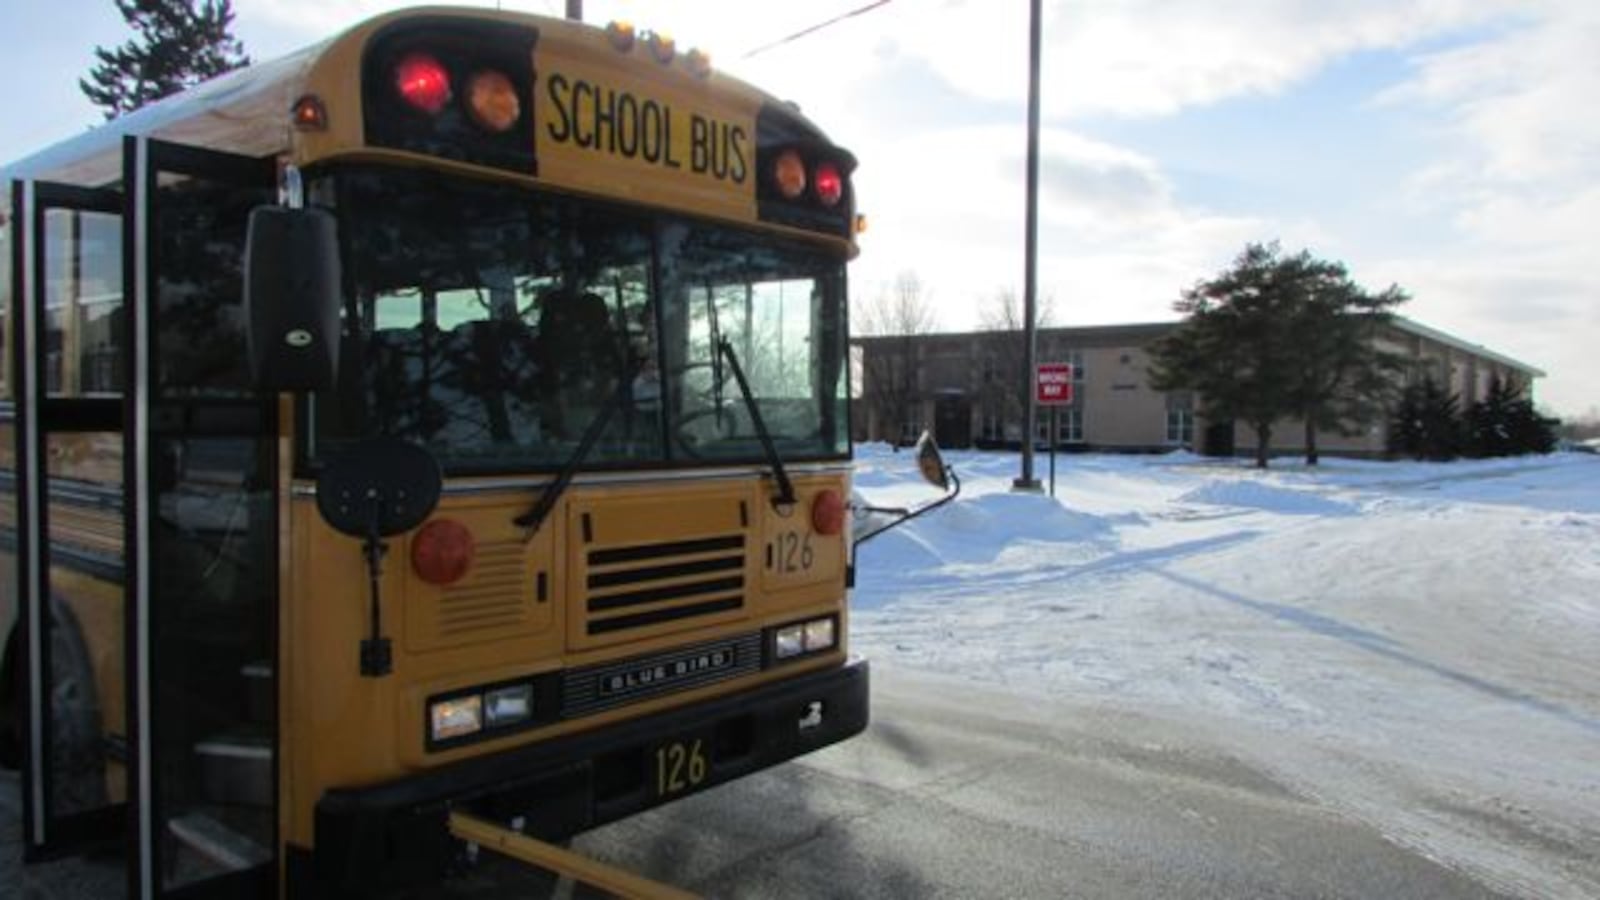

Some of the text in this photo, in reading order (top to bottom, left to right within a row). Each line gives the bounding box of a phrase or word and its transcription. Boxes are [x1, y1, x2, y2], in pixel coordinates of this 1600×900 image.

[547, 73, 747, 184] SCHOOL BUS
[776, 530, 814, 573] 126
[610, 652, 725, 690] BLUE BIRD
[656, 739, 705, 796] 126
